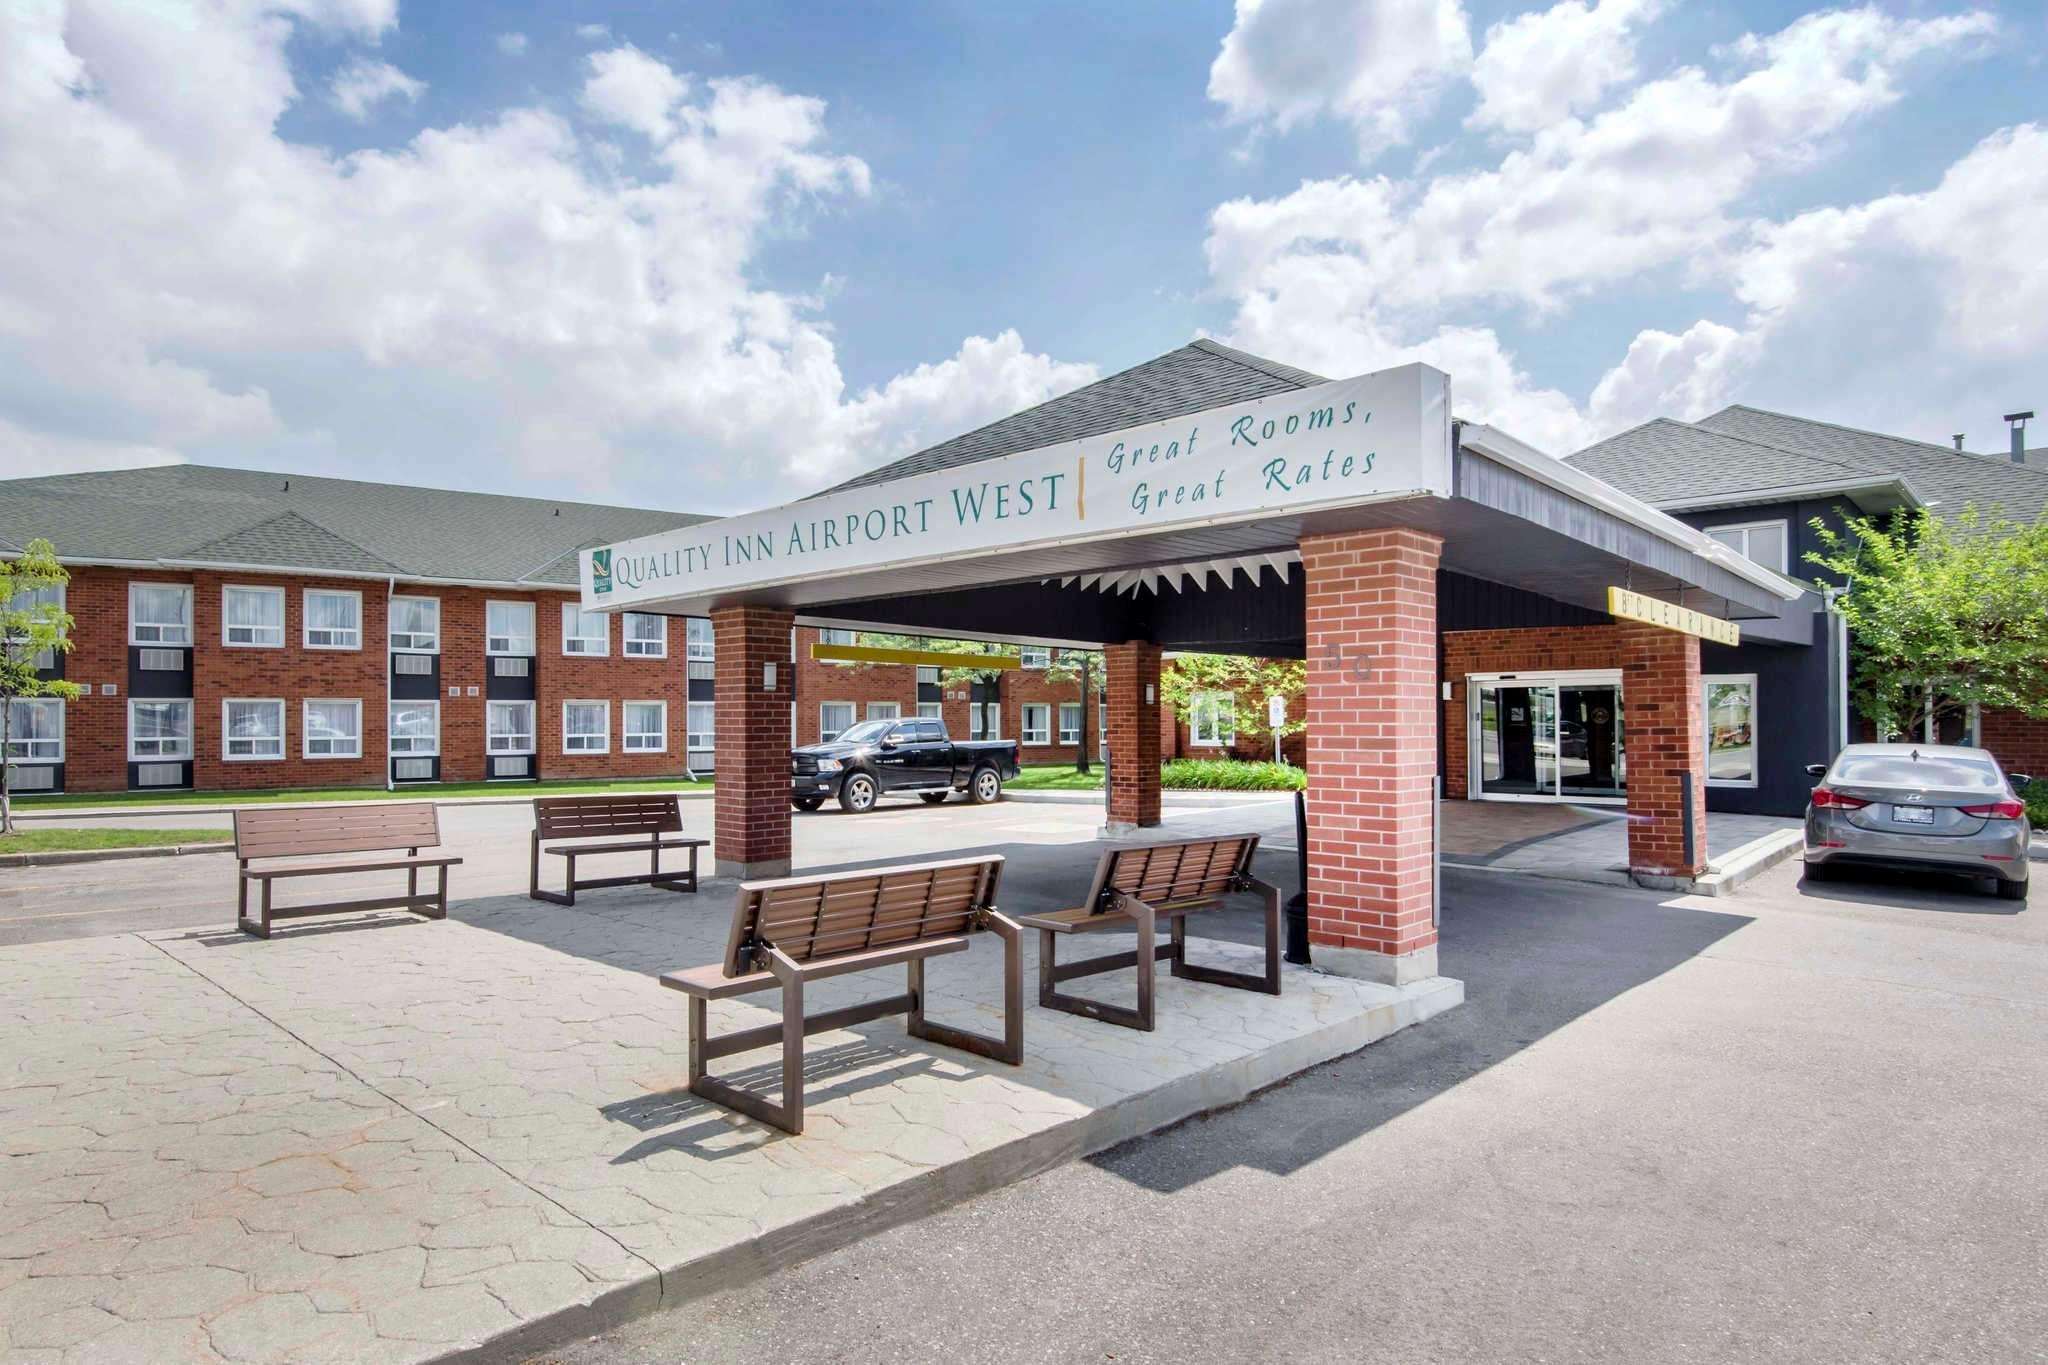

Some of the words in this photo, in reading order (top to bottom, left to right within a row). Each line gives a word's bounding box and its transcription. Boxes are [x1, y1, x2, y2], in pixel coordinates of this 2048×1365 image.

[1107, 427, 1199, 474] Great
[1231, 401, 1373, 447] Rooms,
[1131, 469, 1226, 516] Great
[1262, 449, 1377, 492] Rates
[615, 543, 712, 589] QUALITY
[725, 530, 774, 566] INN
[787, 499, 934, 556] AIRPORT
[951, 473, 1065, 527] WEST
